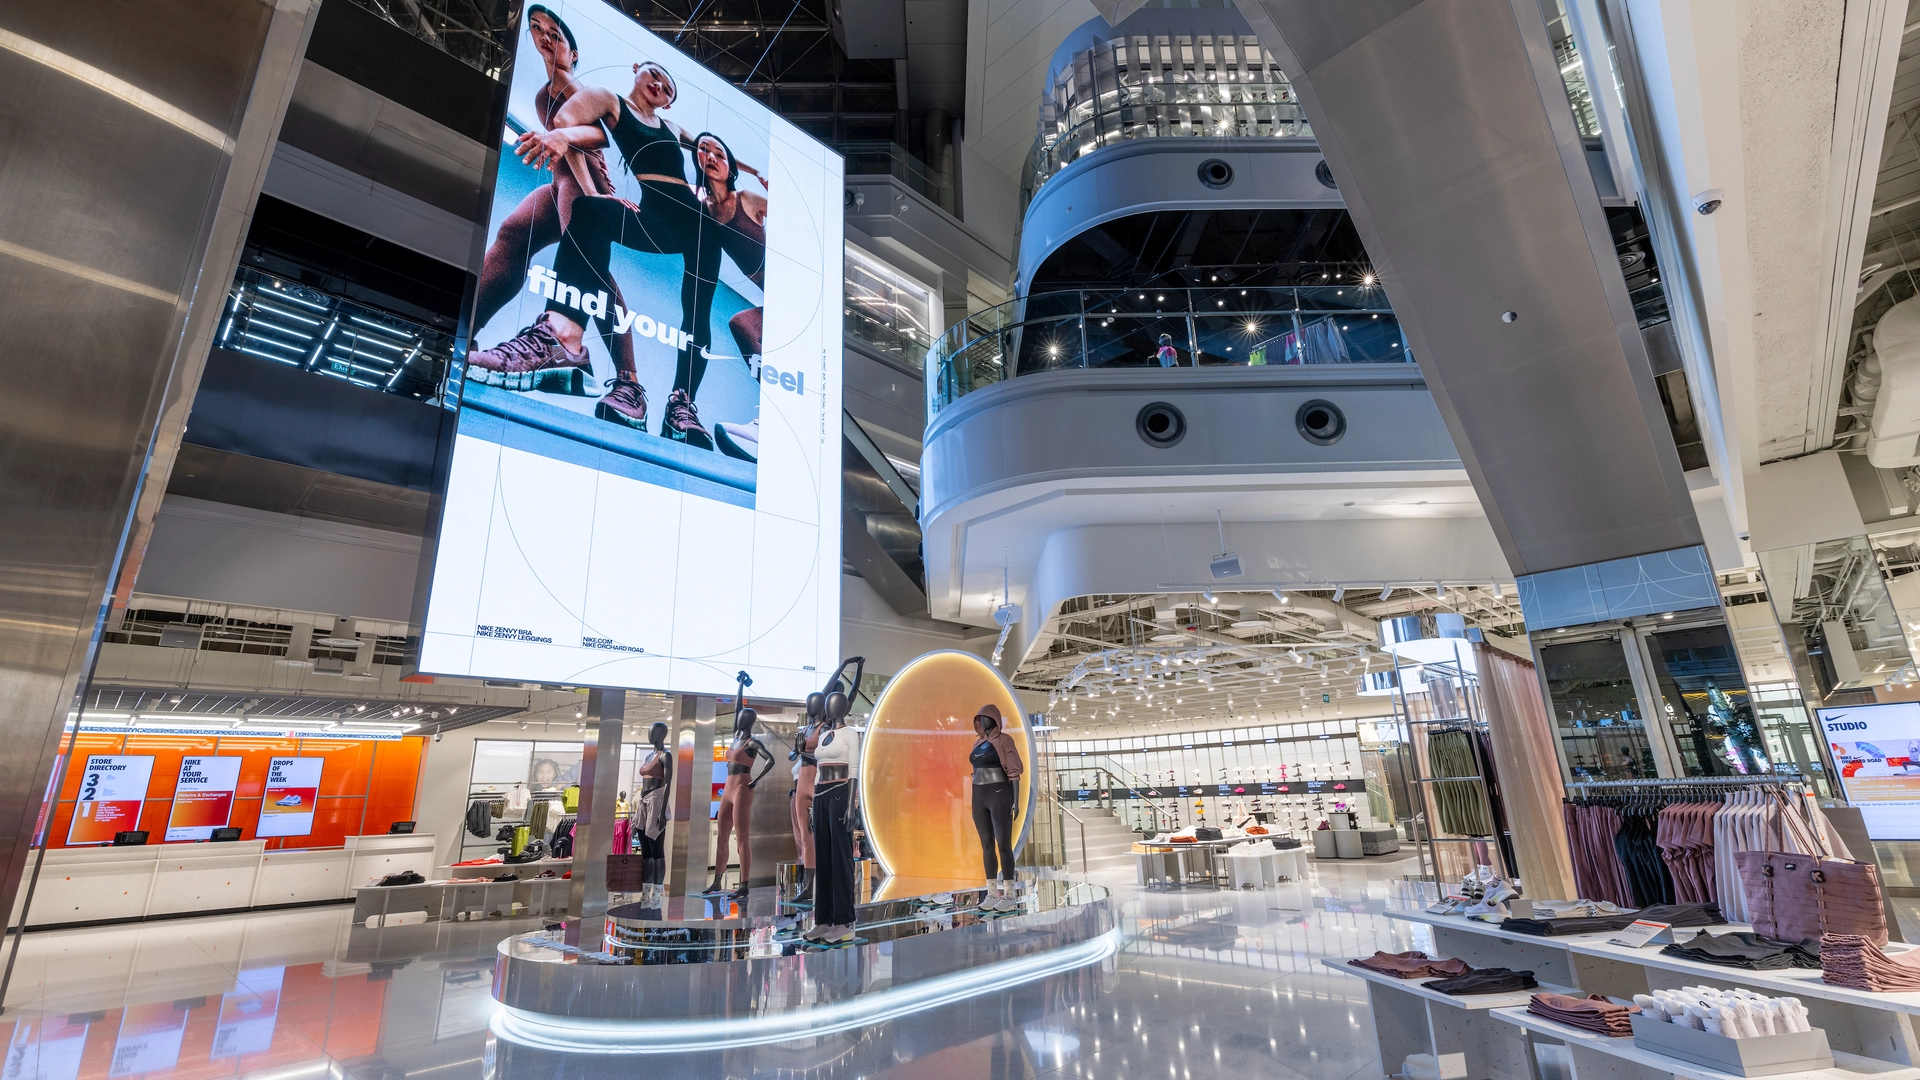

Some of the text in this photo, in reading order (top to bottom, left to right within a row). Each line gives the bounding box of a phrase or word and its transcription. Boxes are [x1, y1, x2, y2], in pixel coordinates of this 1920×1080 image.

[528, 264, 804, 395] find your feel
[518, 635, 552, 643] LEGGINGS
[597, 643, 627, 651] ORCHARD
[1828, 722, 1867, 731] STUDIO
[86, 774, 100, 787] 3
[82, 787, 96, 800] 2
[82, 802, 91, 817] 1
